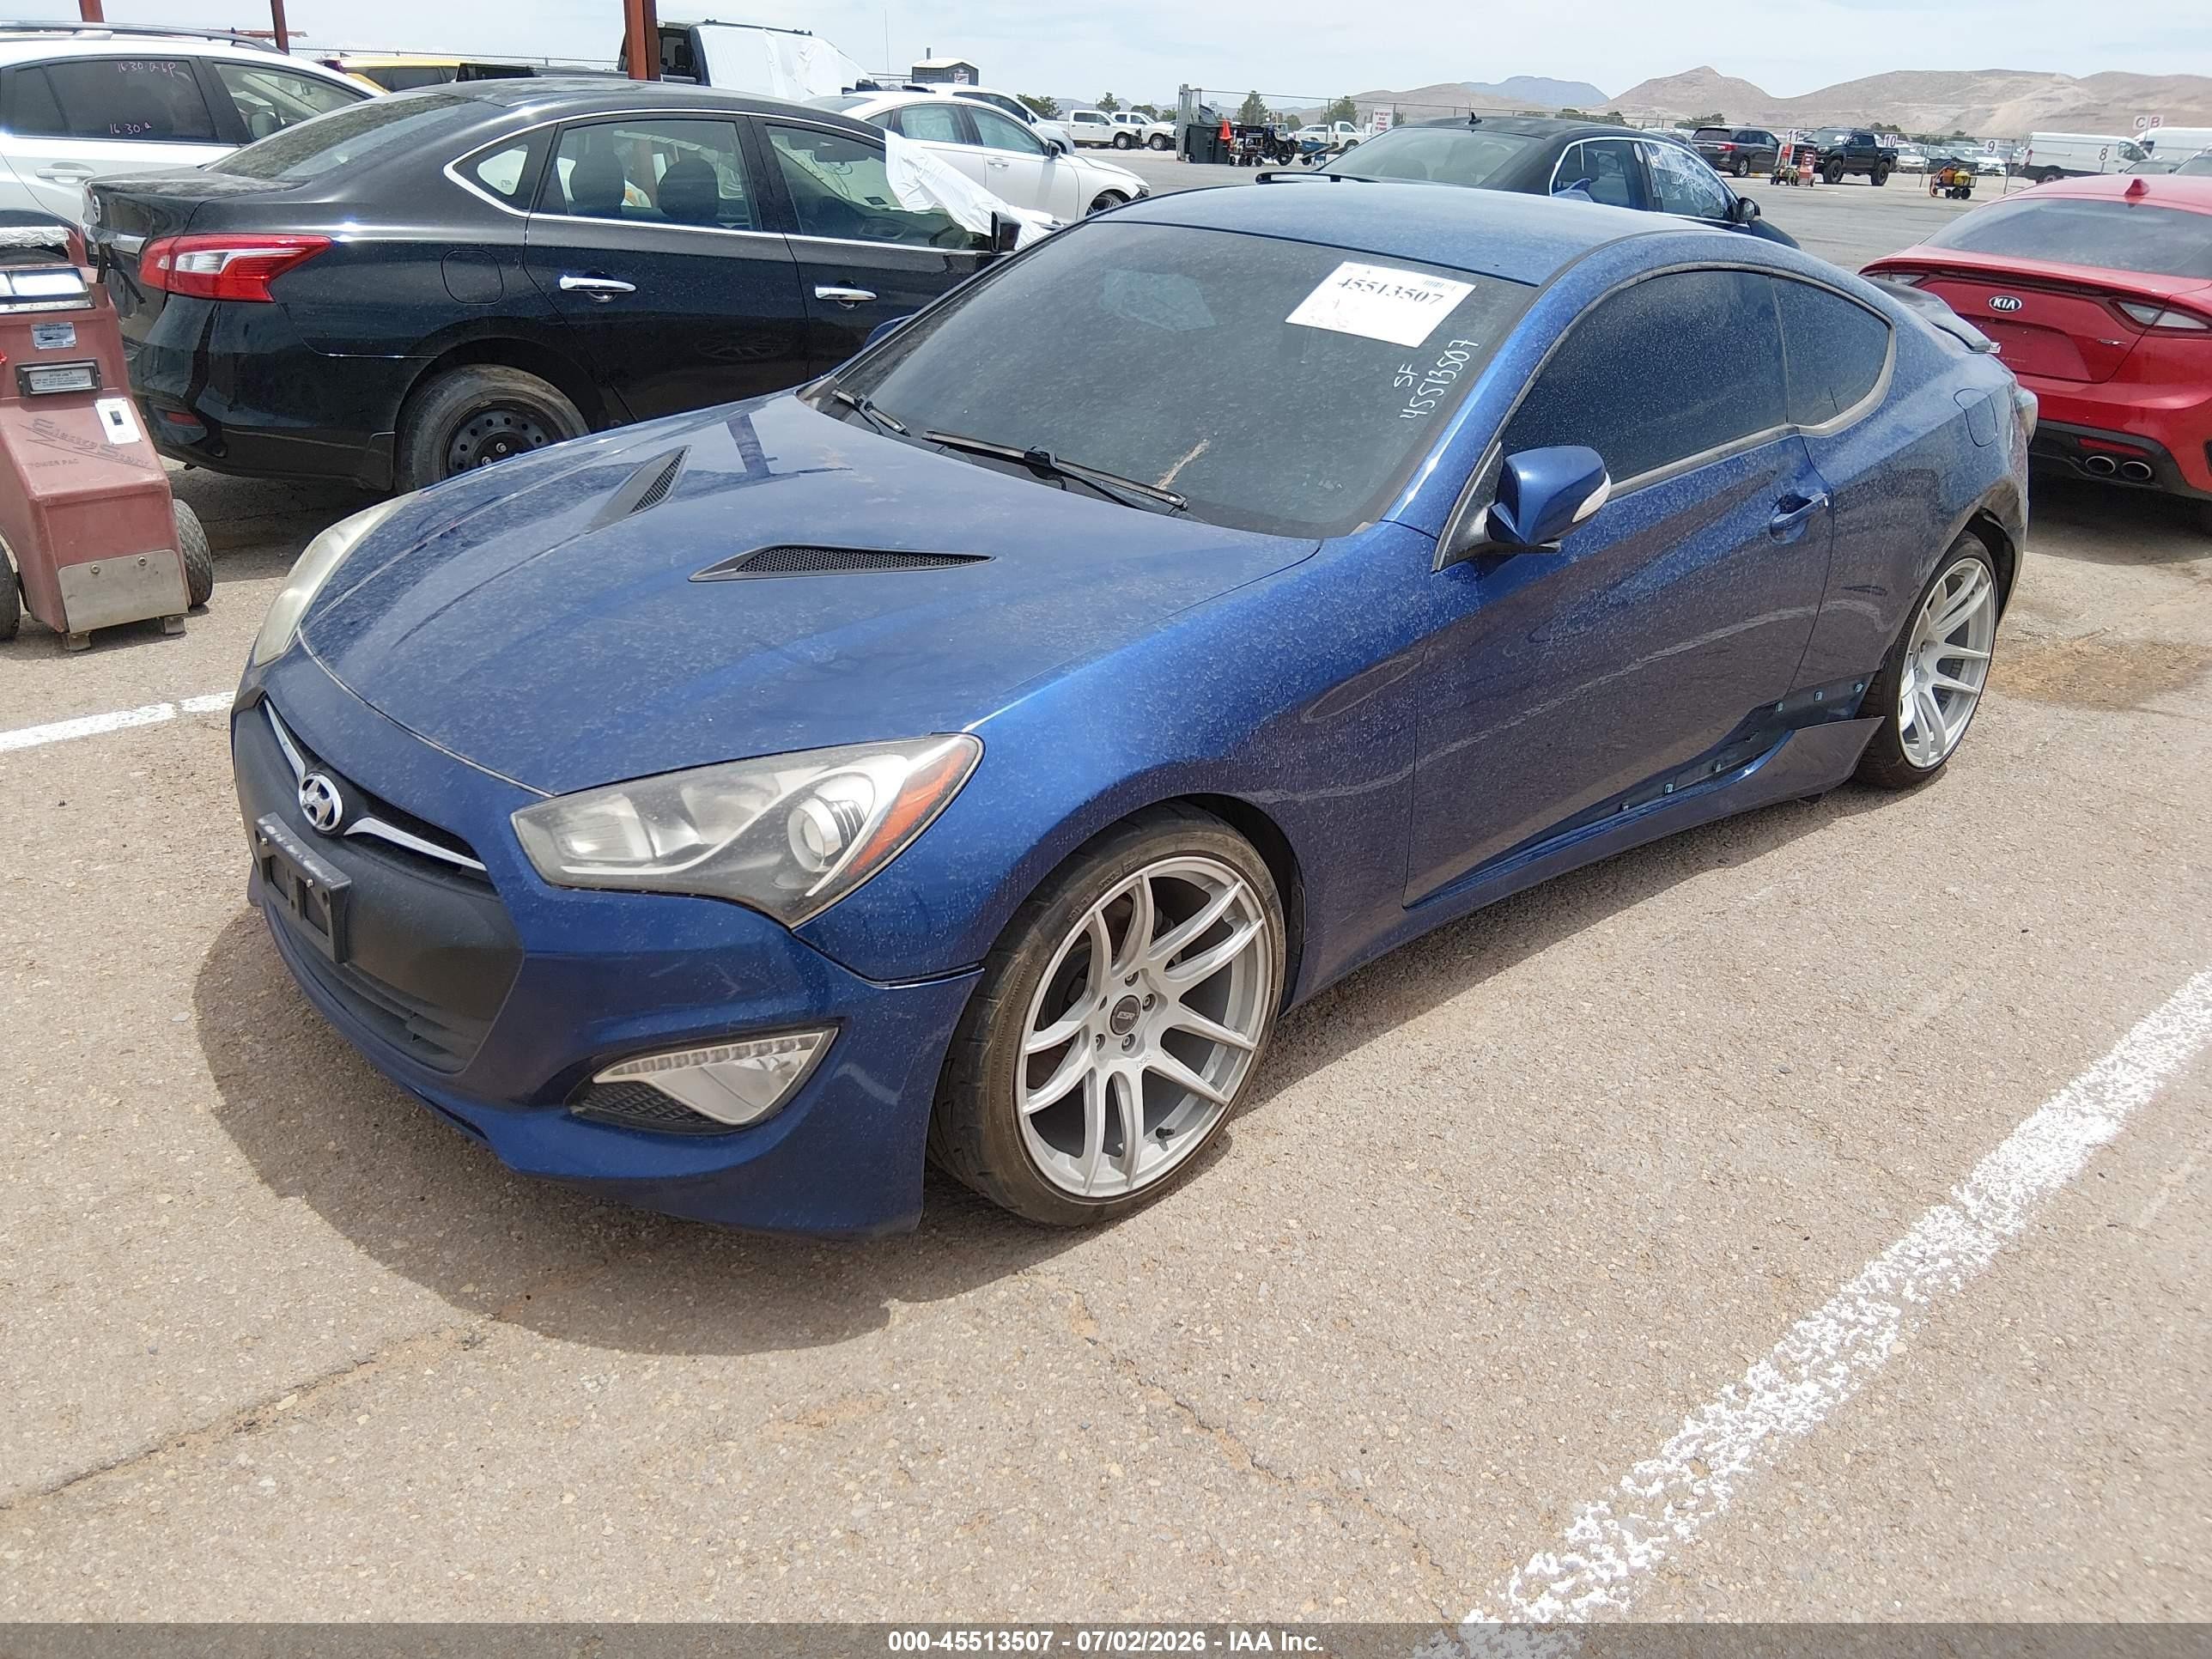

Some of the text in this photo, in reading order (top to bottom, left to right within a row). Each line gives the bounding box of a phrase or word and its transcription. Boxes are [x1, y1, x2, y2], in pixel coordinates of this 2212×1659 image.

[2136, 117, 2146, 129] C
[2149, 116, 2160, 128] B
[1885, 135, 1897, 147] 10
[1987, 140, 1996, 153] 9
[2099, 148, 2108, 161] 8
[1338, 277, 1444, 305] 45513507
[1992, 297, 2016, 310] KIA
[1394, 363, 1419, 387] SF
[1399, 339, 1479, 418] 45513507
